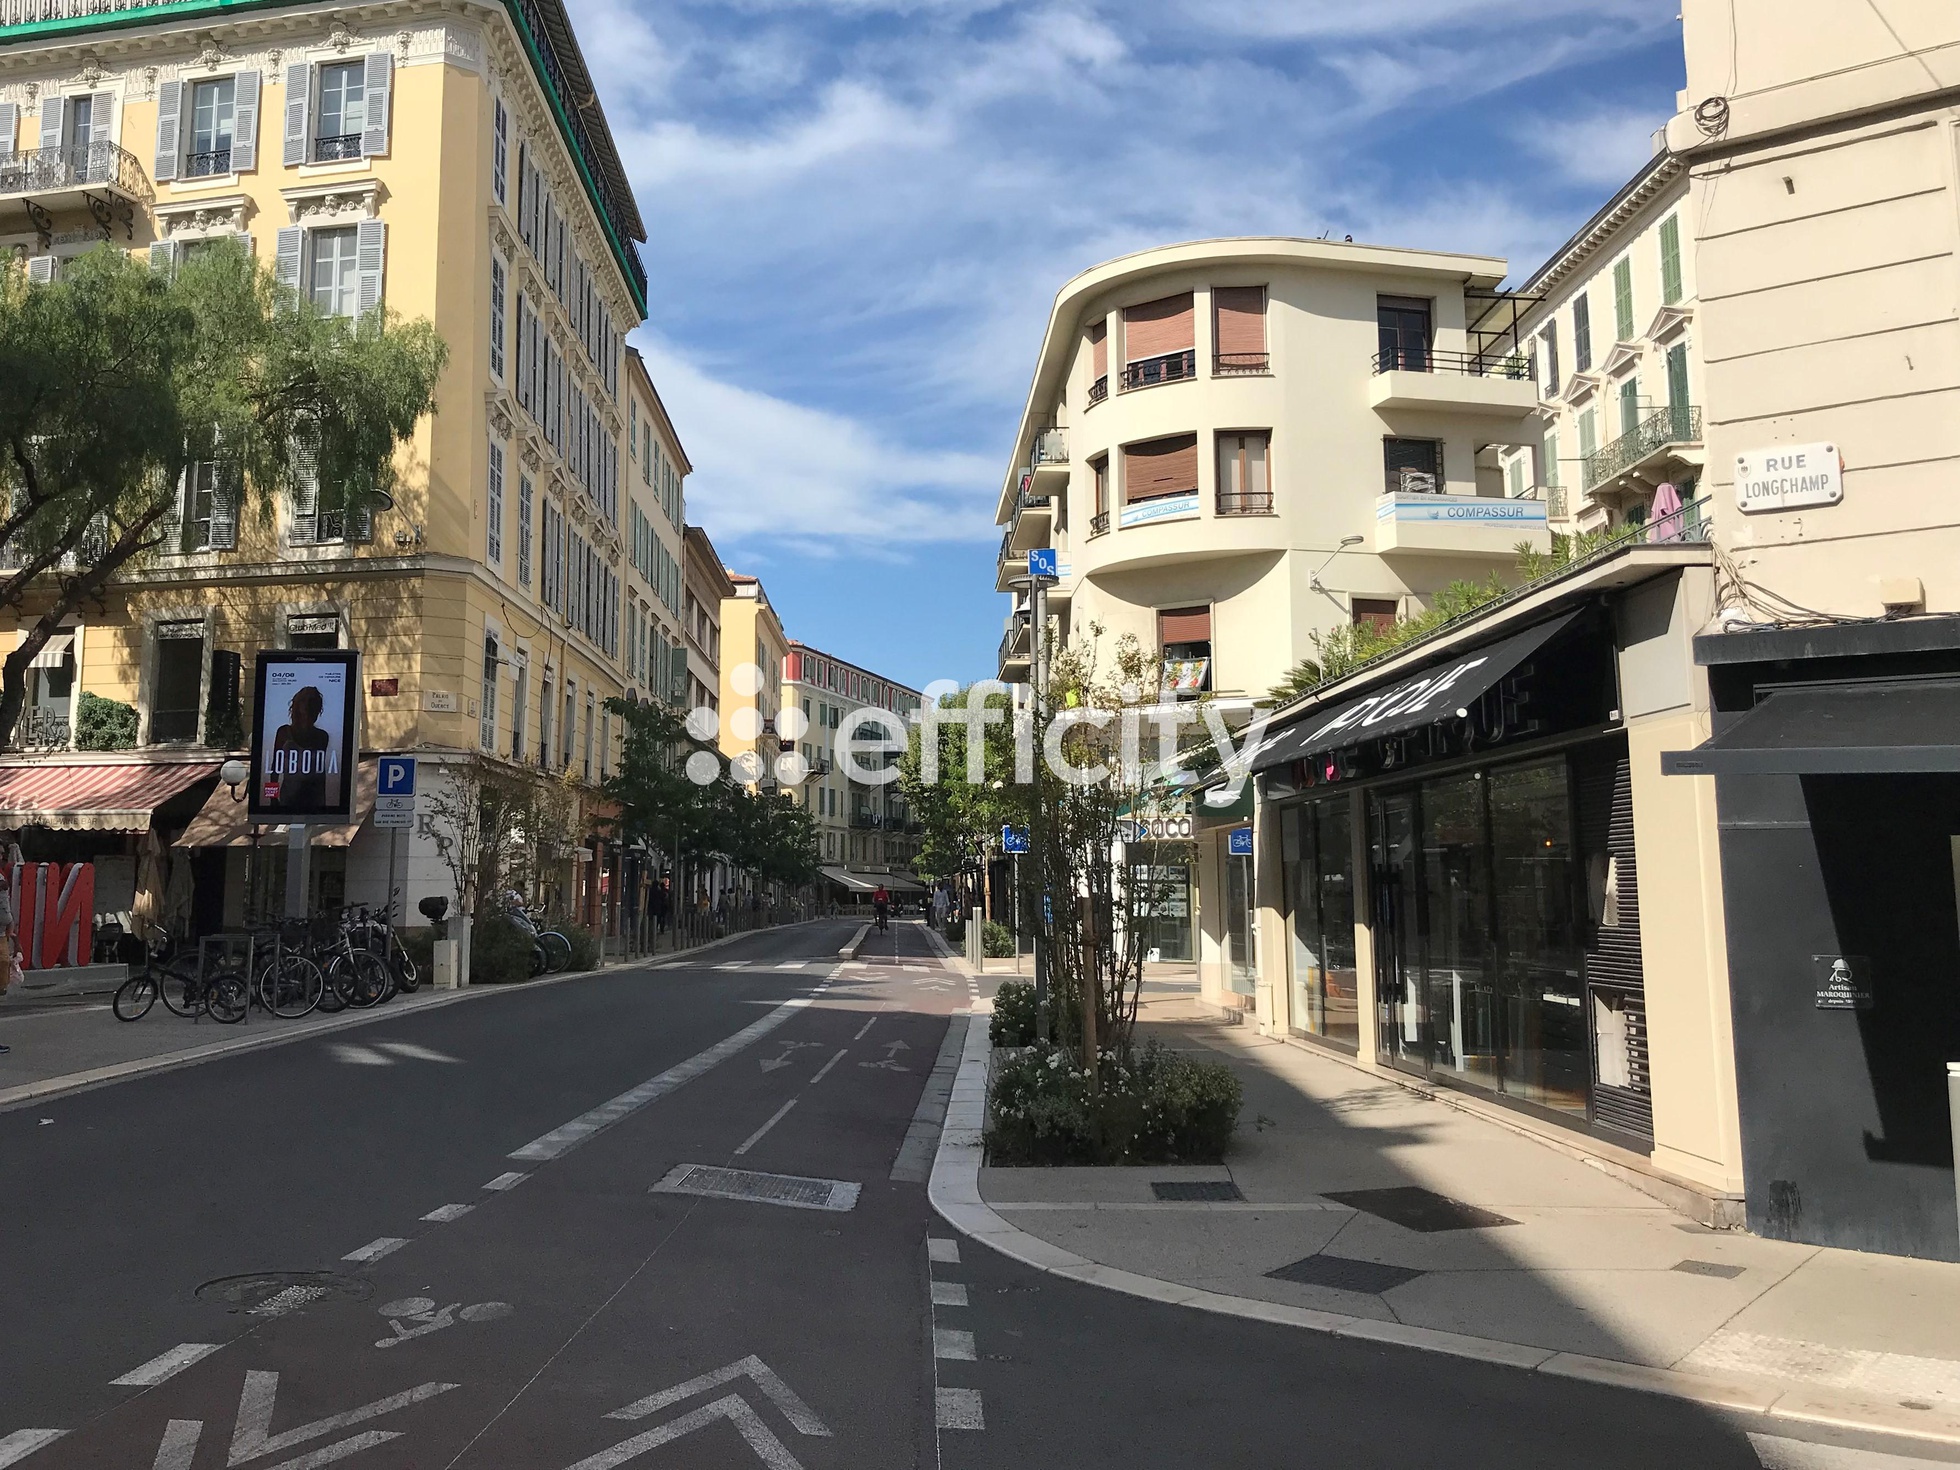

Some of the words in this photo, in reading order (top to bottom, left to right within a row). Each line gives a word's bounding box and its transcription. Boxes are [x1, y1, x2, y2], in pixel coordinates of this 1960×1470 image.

[1766, 454, 1807, 472] RUE
[1745, 474, 1829, 498] LONGCHAMP
[1141, 502, 1190, 518] COMPASSUR
[1447, 506, 1524, 518] COMPASSUR
[1031, 550, 1055, 576] SOS
[265, 749, 338, 774] LOBODA
[387, 764, 406, 789] P
[1816, 990, 1871, 999] MAROQUINIER
